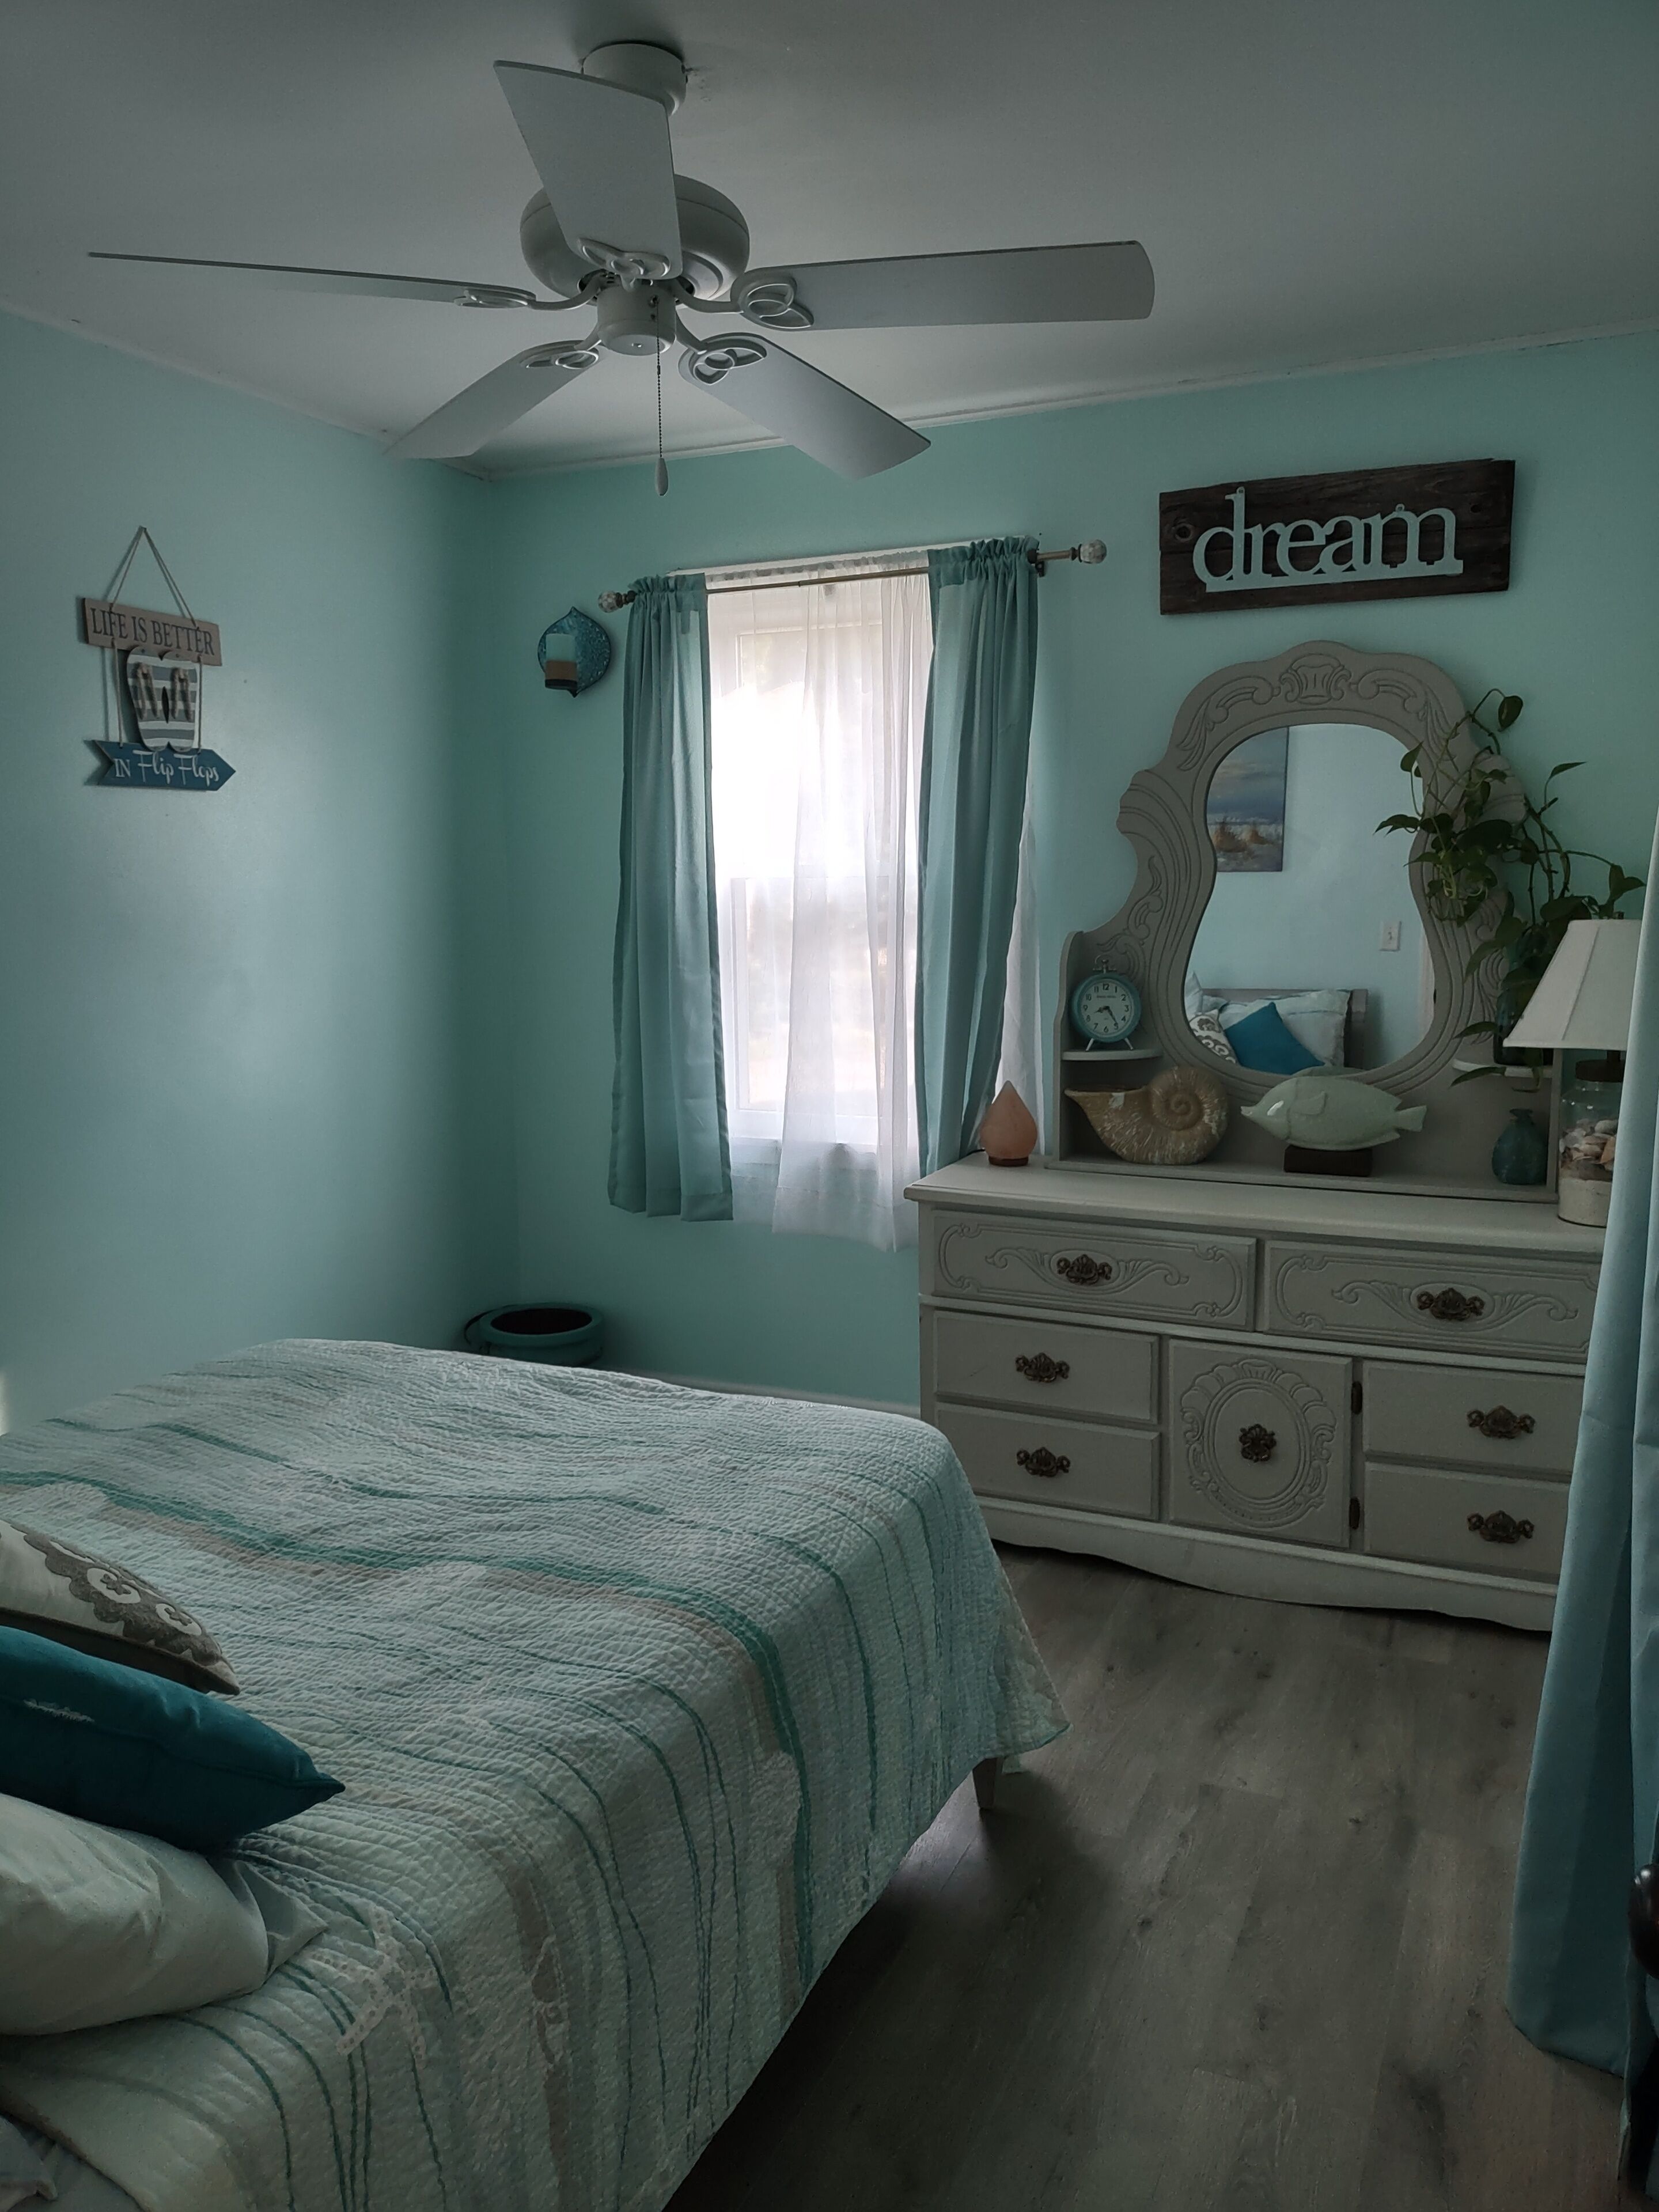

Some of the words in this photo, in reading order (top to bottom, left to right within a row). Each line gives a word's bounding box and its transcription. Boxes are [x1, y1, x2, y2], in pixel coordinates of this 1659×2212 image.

[1192, 487, 1464, 593] dream
[90, 608, 128, 639] LIFE
[131, 616, 147, 643] IS
[151, 620, 215, 656] BETTER
[113, 758, 131, 778] IN
[132, 749, 174, 785] Flip
[173, 753, 219, 787] Flops
[1093, 1022, 1099, 1031] 7
